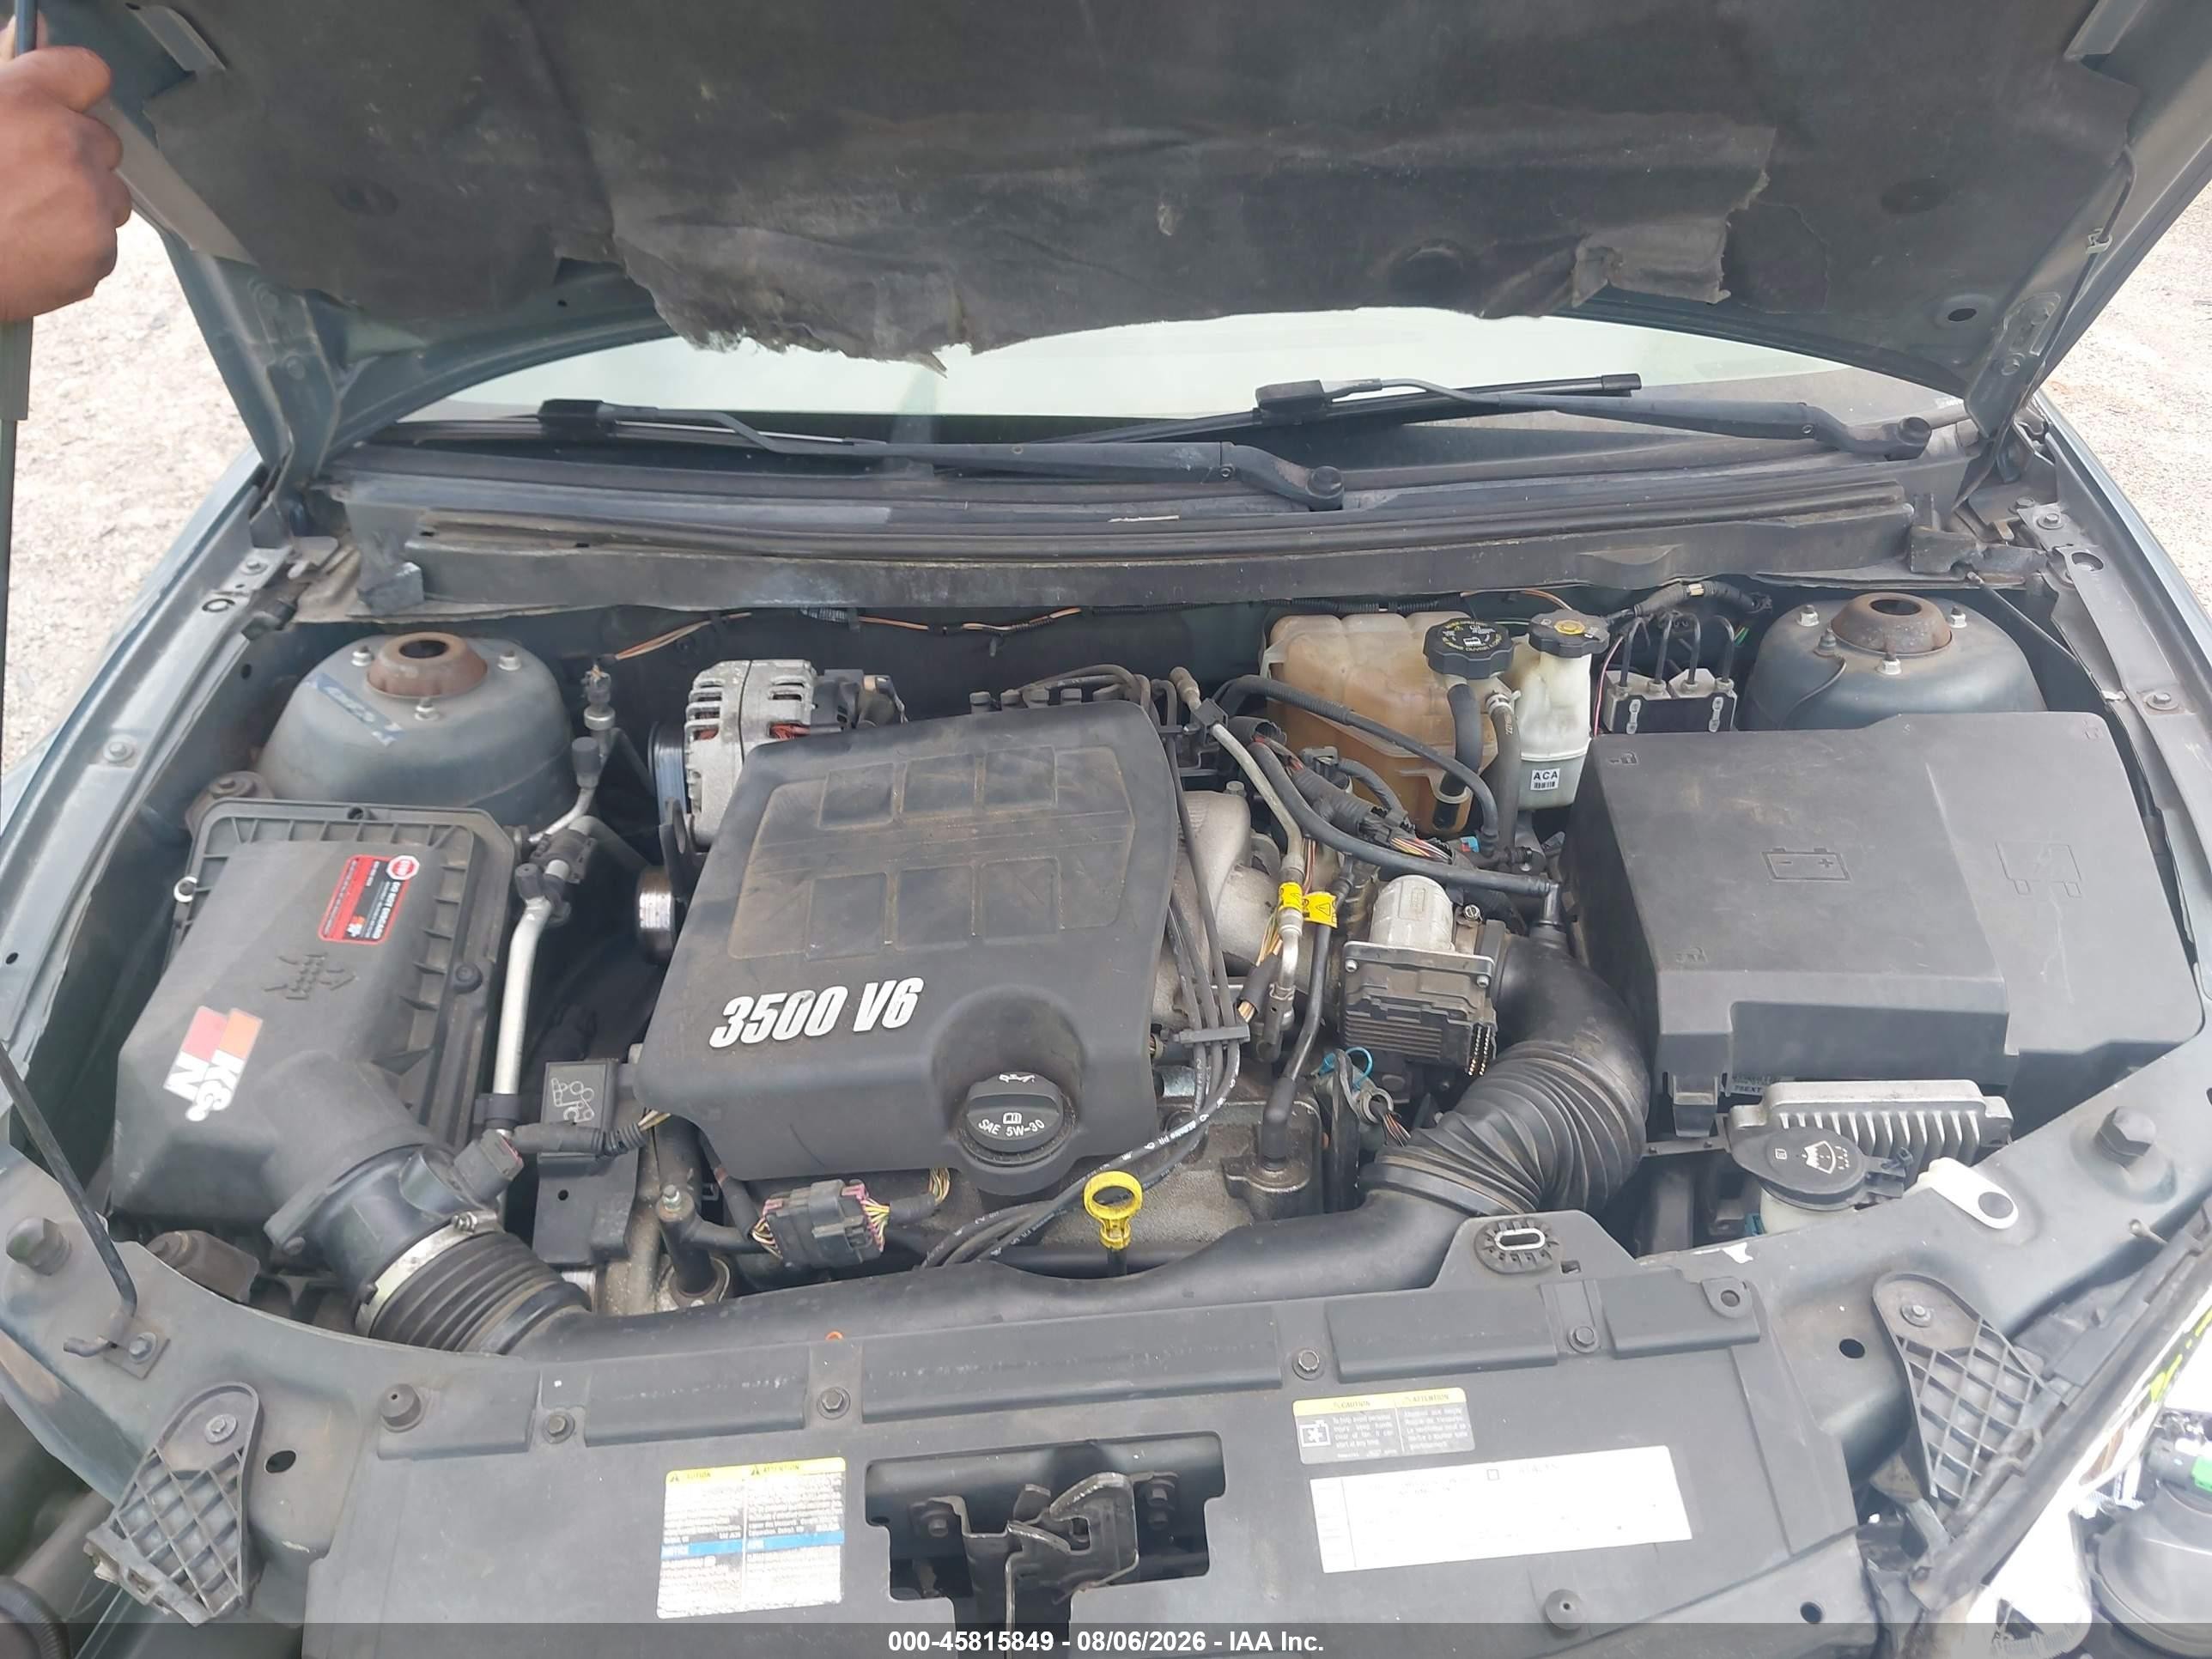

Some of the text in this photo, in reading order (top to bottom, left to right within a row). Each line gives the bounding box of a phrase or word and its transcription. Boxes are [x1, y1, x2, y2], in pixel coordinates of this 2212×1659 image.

[1533, 770, 1559, 781] ACA
[709, 977, 924, 1048] 3500 V6
[163, 1032, 254, 1121] K&N
[978, 1119, 1045, 1137] SAE 5W-30
[1413, 1394, 1449, 1402] ATTENTION
